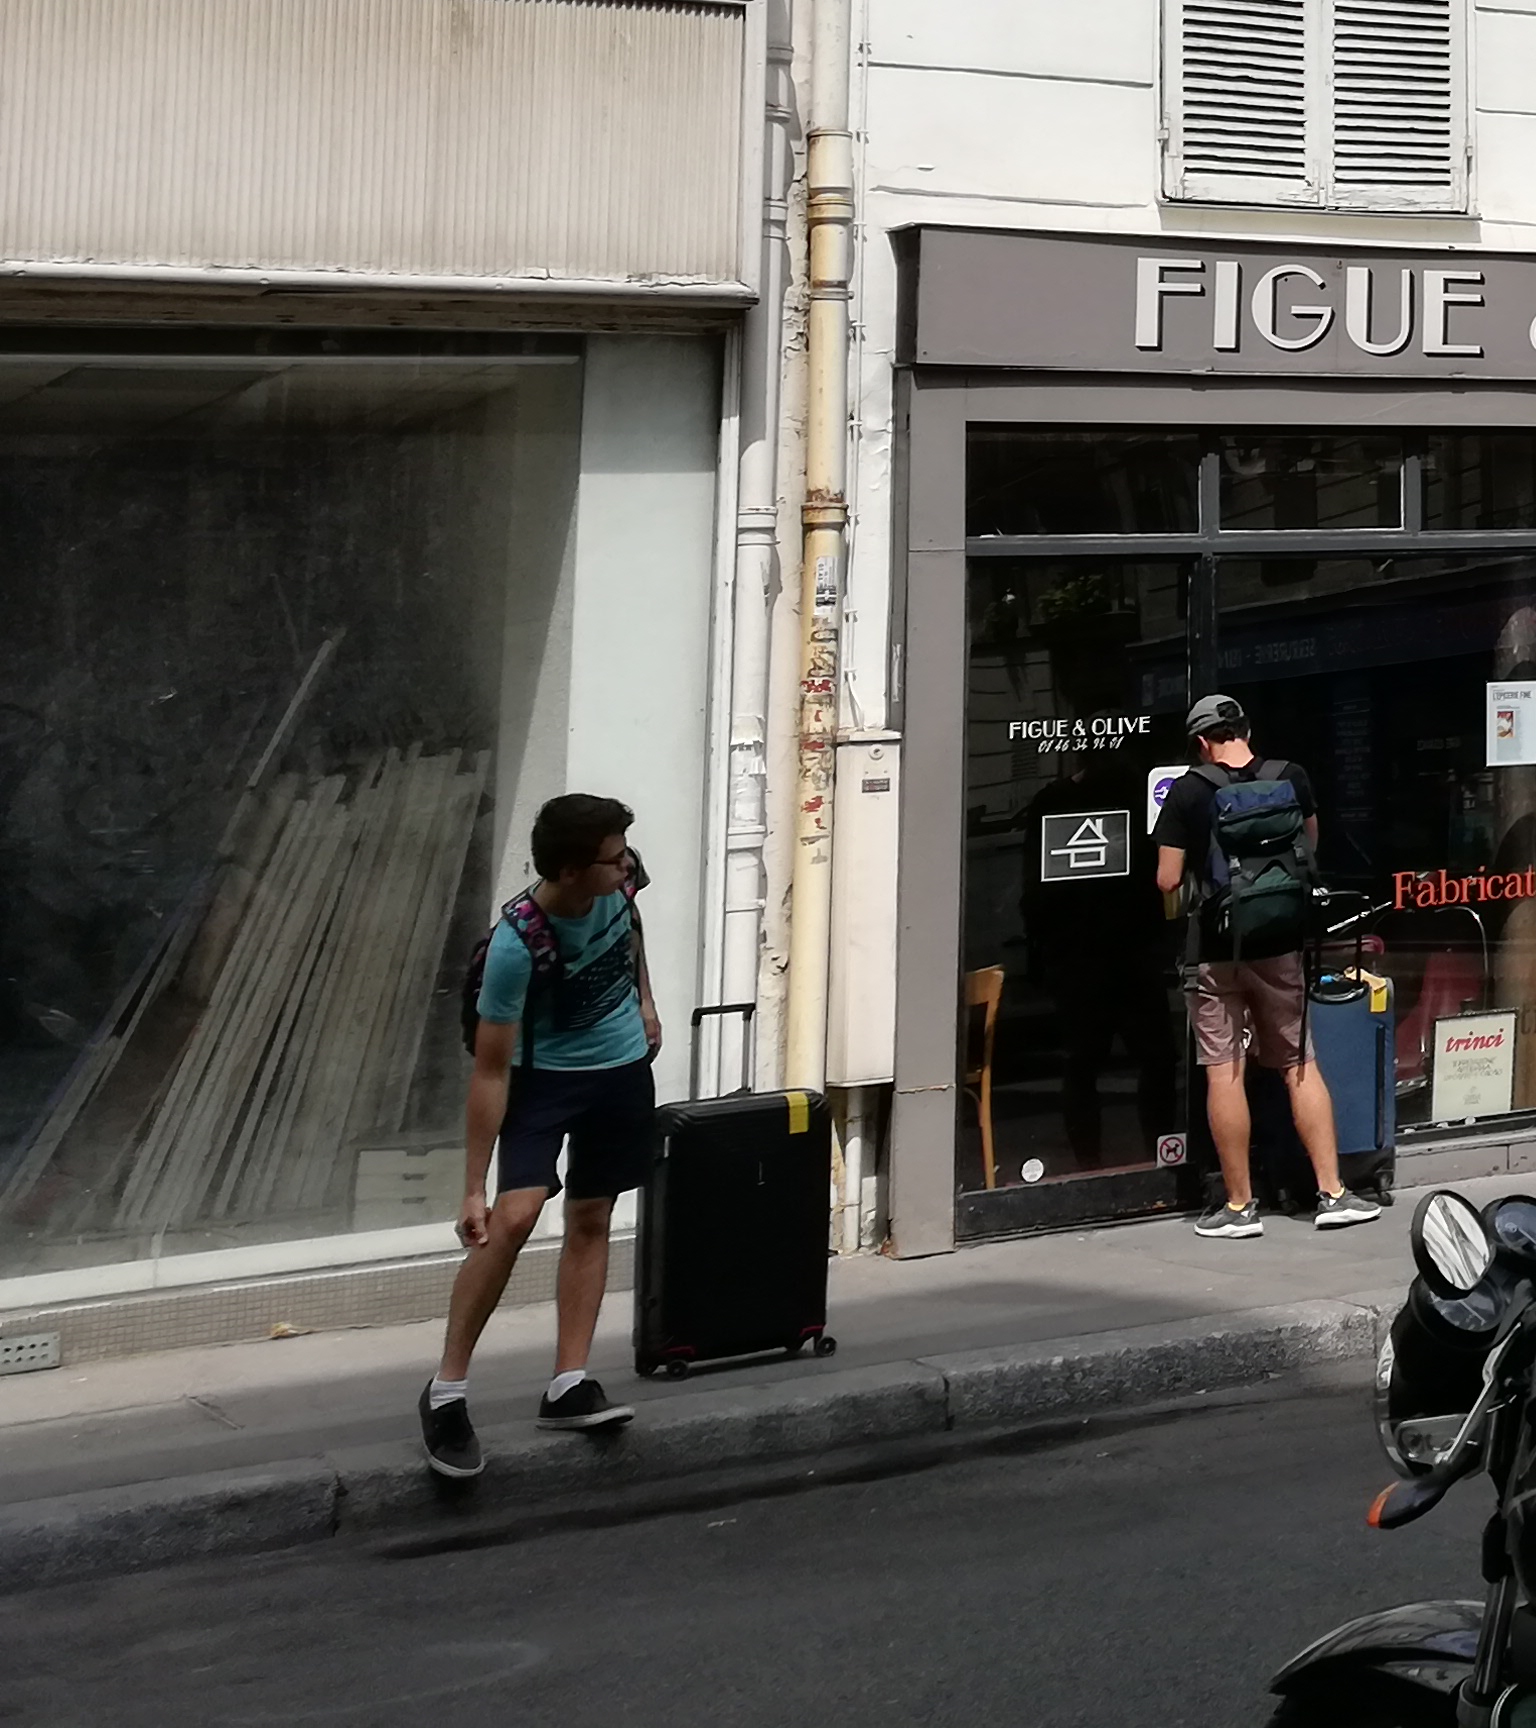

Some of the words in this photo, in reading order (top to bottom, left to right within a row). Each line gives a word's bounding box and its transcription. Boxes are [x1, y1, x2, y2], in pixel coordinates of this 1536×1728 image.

[1133, 256, 1485, 357] FIGUE
[1009, 719, 1069, 740] FIGUE
[1071, 719, 1086, 737] &
[1091, 715, 1151, 736] OLIVE
[1445, 1028, 1505, 1053] trinci
